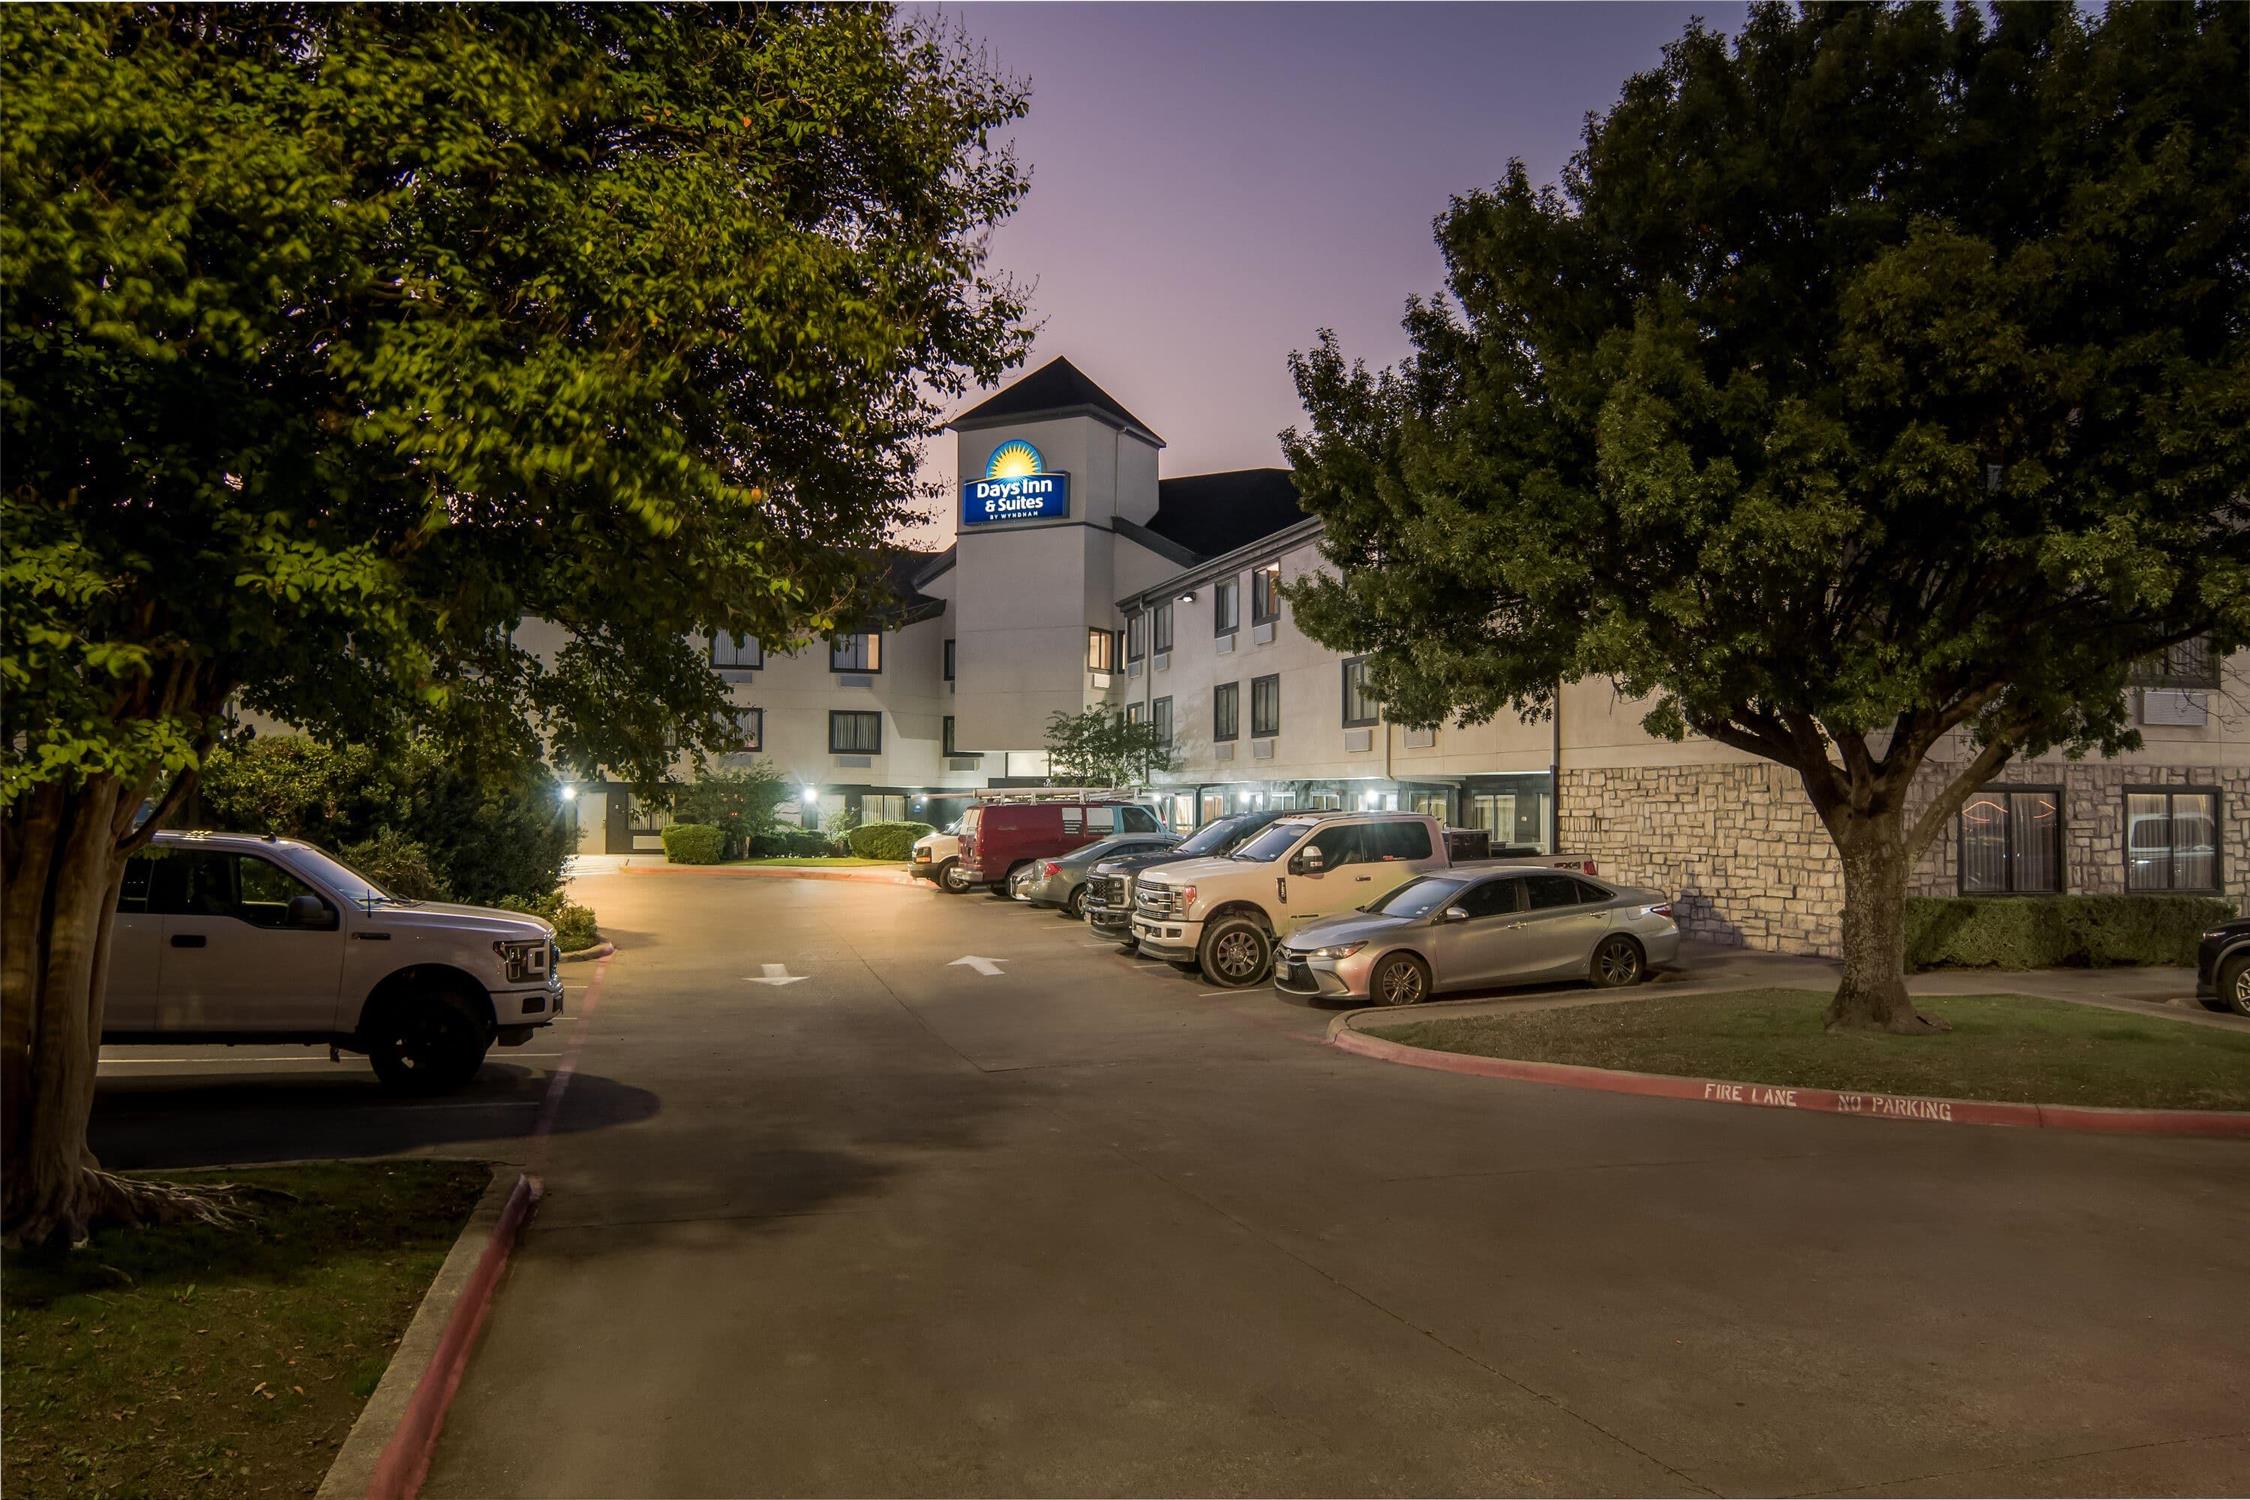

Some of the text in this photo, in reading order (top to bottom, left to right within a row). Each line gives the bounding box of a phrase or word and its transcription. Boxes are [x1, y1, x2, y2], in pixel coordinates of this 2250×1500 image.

[977, 479, 1052, 498] Days Inn
[985, 496, 1043, 512] & Suites
[1000, 511, 1038, 519] WYNDHAM
[1704, 1083, 1952, 1122] FIRE LANE NO PARKING
